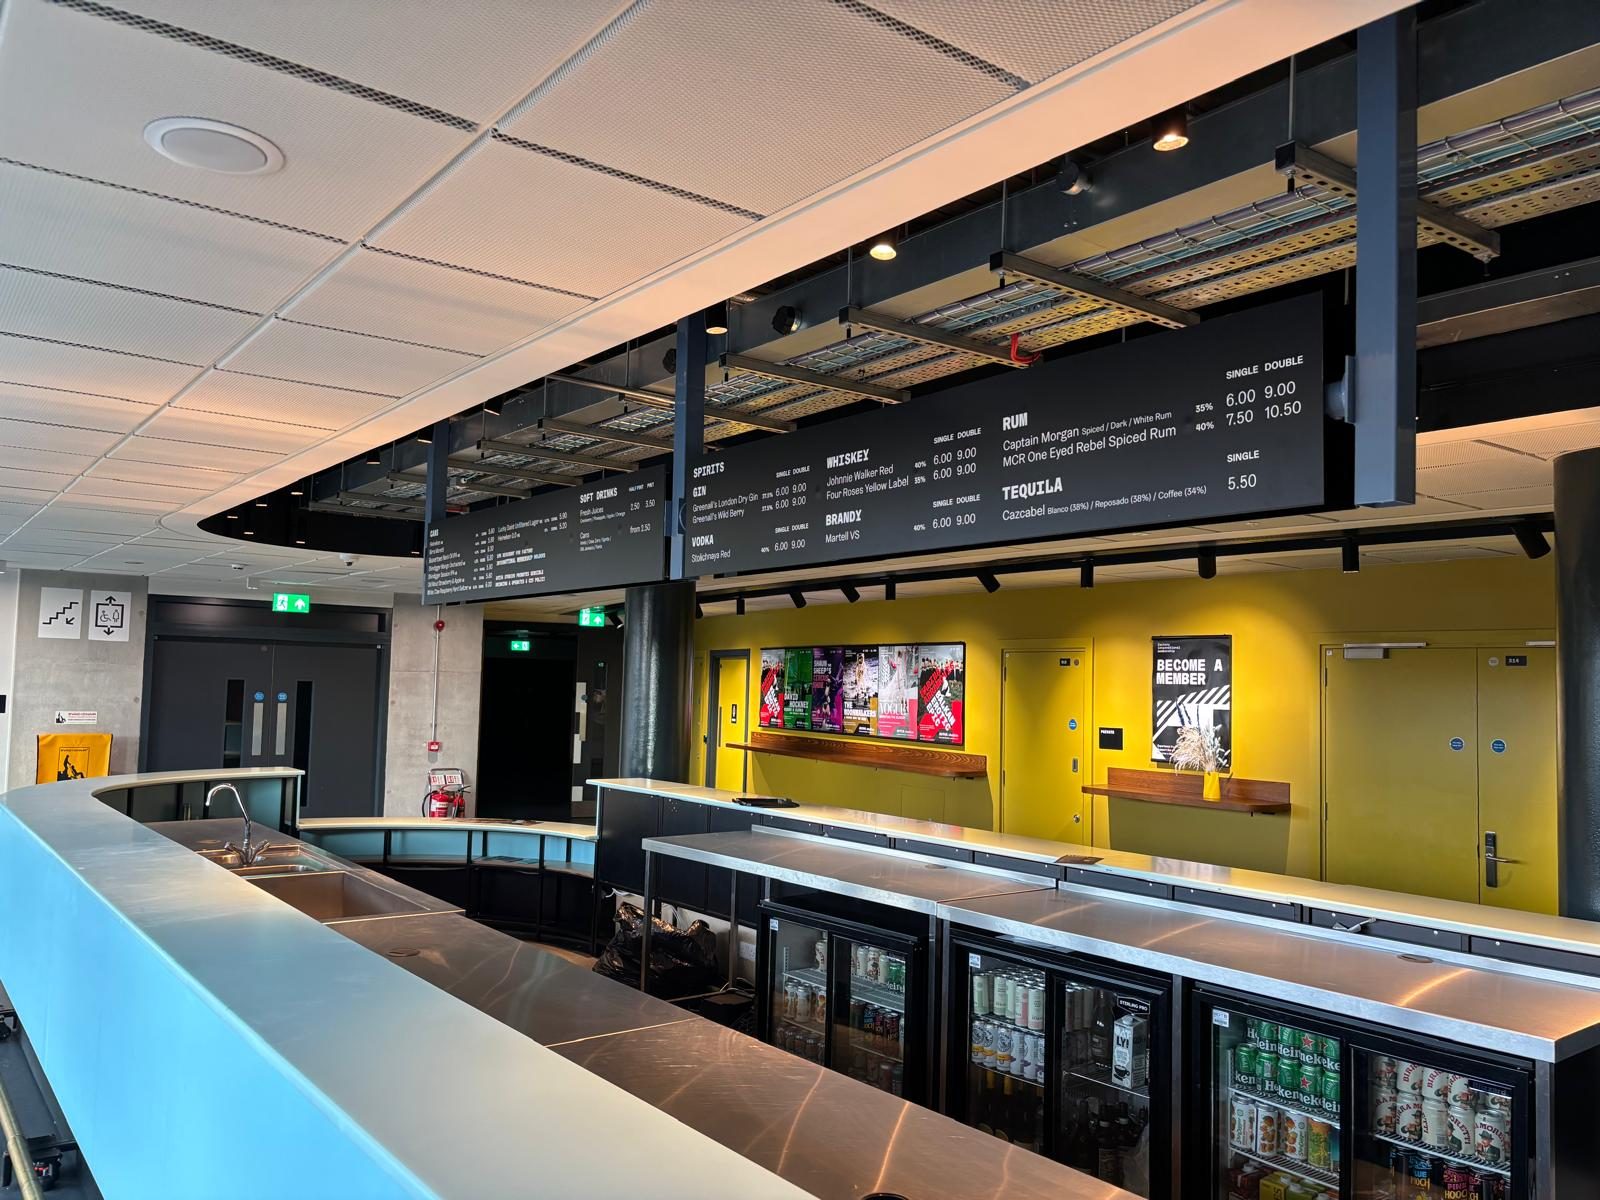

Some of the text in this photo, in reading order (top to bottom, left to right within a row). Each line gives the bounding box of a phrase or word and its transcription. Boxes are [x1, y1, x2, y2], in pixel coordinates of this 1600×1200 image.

[1226, 355, 1304, 380] SINGLE DOUBLE
[1002, 434, 1039, 452] Captain
[1041, 428, 1080, 444] Morgan
[1081, 424, 1104, 436] Spiced
[1110, 419, 1128, 430] Dark
[1133, 415, 1154, 425] White
[1155, 411, 1172, 421] Rum
[1195, 402, 1214, 413] 35%
[1226, 388, 1256, 407] 6.00
[1264, 380, 1296, 399] 9.00
[1002, 412, 1028, 431] RUM
[934, 427, 982, 444] SINGLE DOUBLE
[1002, 400, 1302, 468] MCR One Eyed Rebel Spiced Rum 40% 7.50 10.50
[826, 448, 870, 469] WHISKEY
[1227, 450, 1260, 462] SINGLE
[693, 462, 725, 478] SPIRITS
[776, 465, 810, 478] SINGLE DOUBLE
[826, 474, 853, 487] Johnnie
[854, 468, 878, 482] Walker
[880, 464, 894, 476] Red
[933, 452, 952, 465] 6.00
[956, 446, 977, 461] 9.00
[826, 490, 842, 500] Four
[843, 486, 864, 498] Roses
[865, 480, 888, 494] Yellow
[888, 475, 909, 490] Label
[933, 467, 952, 480] 6.00
[956, 462, 977, 476] 9.00
[1002, 476, 1063, 500] TEQUILA
[580, 488, 618, 504] SOFT DRINKS
[692, 485, 707, 498] GIN
[692, 501, 718, 512] Greenall's
[718, 496, 738, 508] London
[738, 495, 748, 506] Dry
[748, 492, 758, 502] Gin
[775, 486, 790, 497] 6.00
[792, 482, 807, 494] 9.00
[932, 494, 980, 508] SINGLE DOUBLE
[1002, 504, 1046, 521] Cazcabel
[1048, 505, 1069, 515] Blanco
[1070, 501, 1089, 513] (38%)
[1094, 498, 1129, 509] Reposado
[1130, 493, 1152, 504] (38%)
[1158, 490, 1182, 500] Coffee
[1184, 486, 1207, 497] (34%)
[1228, 473, 1257, 490] 5.50
[692, 512, 717, 524] Greenall's
[718, 510, 729, 520] Wild
[730, 508, 745, 518] Berry
[775, 499, 790, 510] 6.00
[792, 496, 807, 506] 9.00
[826, 509, 862, 526] BRANDY
[630, 526, 640, 534] from
[774, 522, 808, 534] SINGLE DOUBLE
[826, 532, 849, 543] Martell
[849, 530, 860, 540] VS
[932, 517, 952, 529] 6.00
[956, 513, 976, 526] 9.00
[692, 534, 714, 548] VODKA
[692, 552, 720, 563] Stolichnaya
[720, 549, 731, 559] Red
[774, 541, 788, 552] 6.00
[791, 538, 806, 549] 9.00
[1156, 658, 1224, 672] BECOME A
[1156, 672, 1206, 686] MEMBER
[925, 702, 940, 726] EPIC
[934, 689, 955, 725] BALKAN
[1120, 1001, 1139, 1009] STERLING
